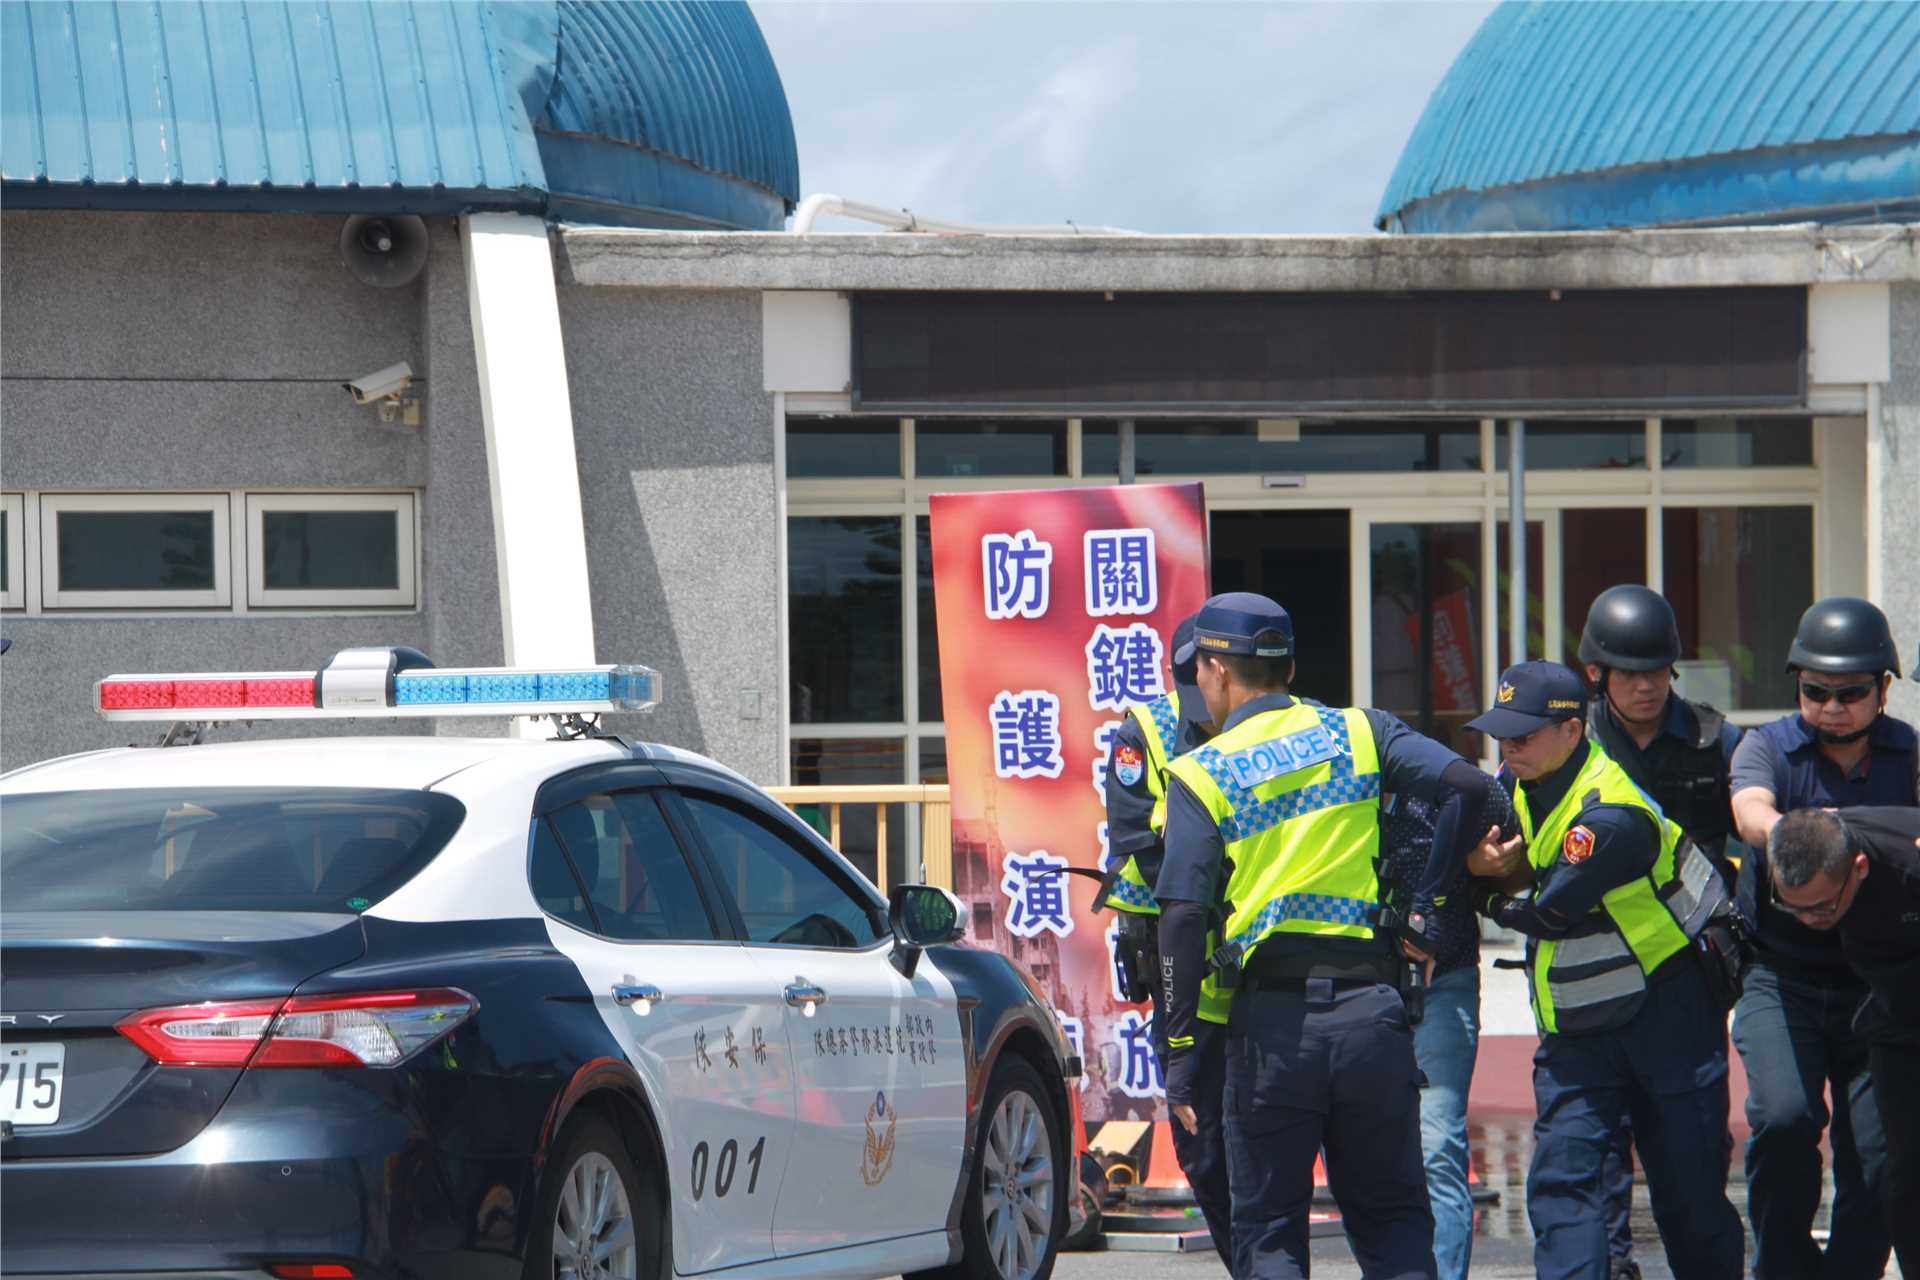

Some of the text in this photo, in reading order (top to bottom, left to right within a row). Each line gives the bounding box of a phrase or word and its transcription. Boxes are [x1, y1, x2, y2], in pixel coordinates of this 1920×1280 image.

[1234, 729, 1328, 780] POLICE
[1162, 955, 1174, 1013] POLICE
[692, 1136, 765, 1201] 001
